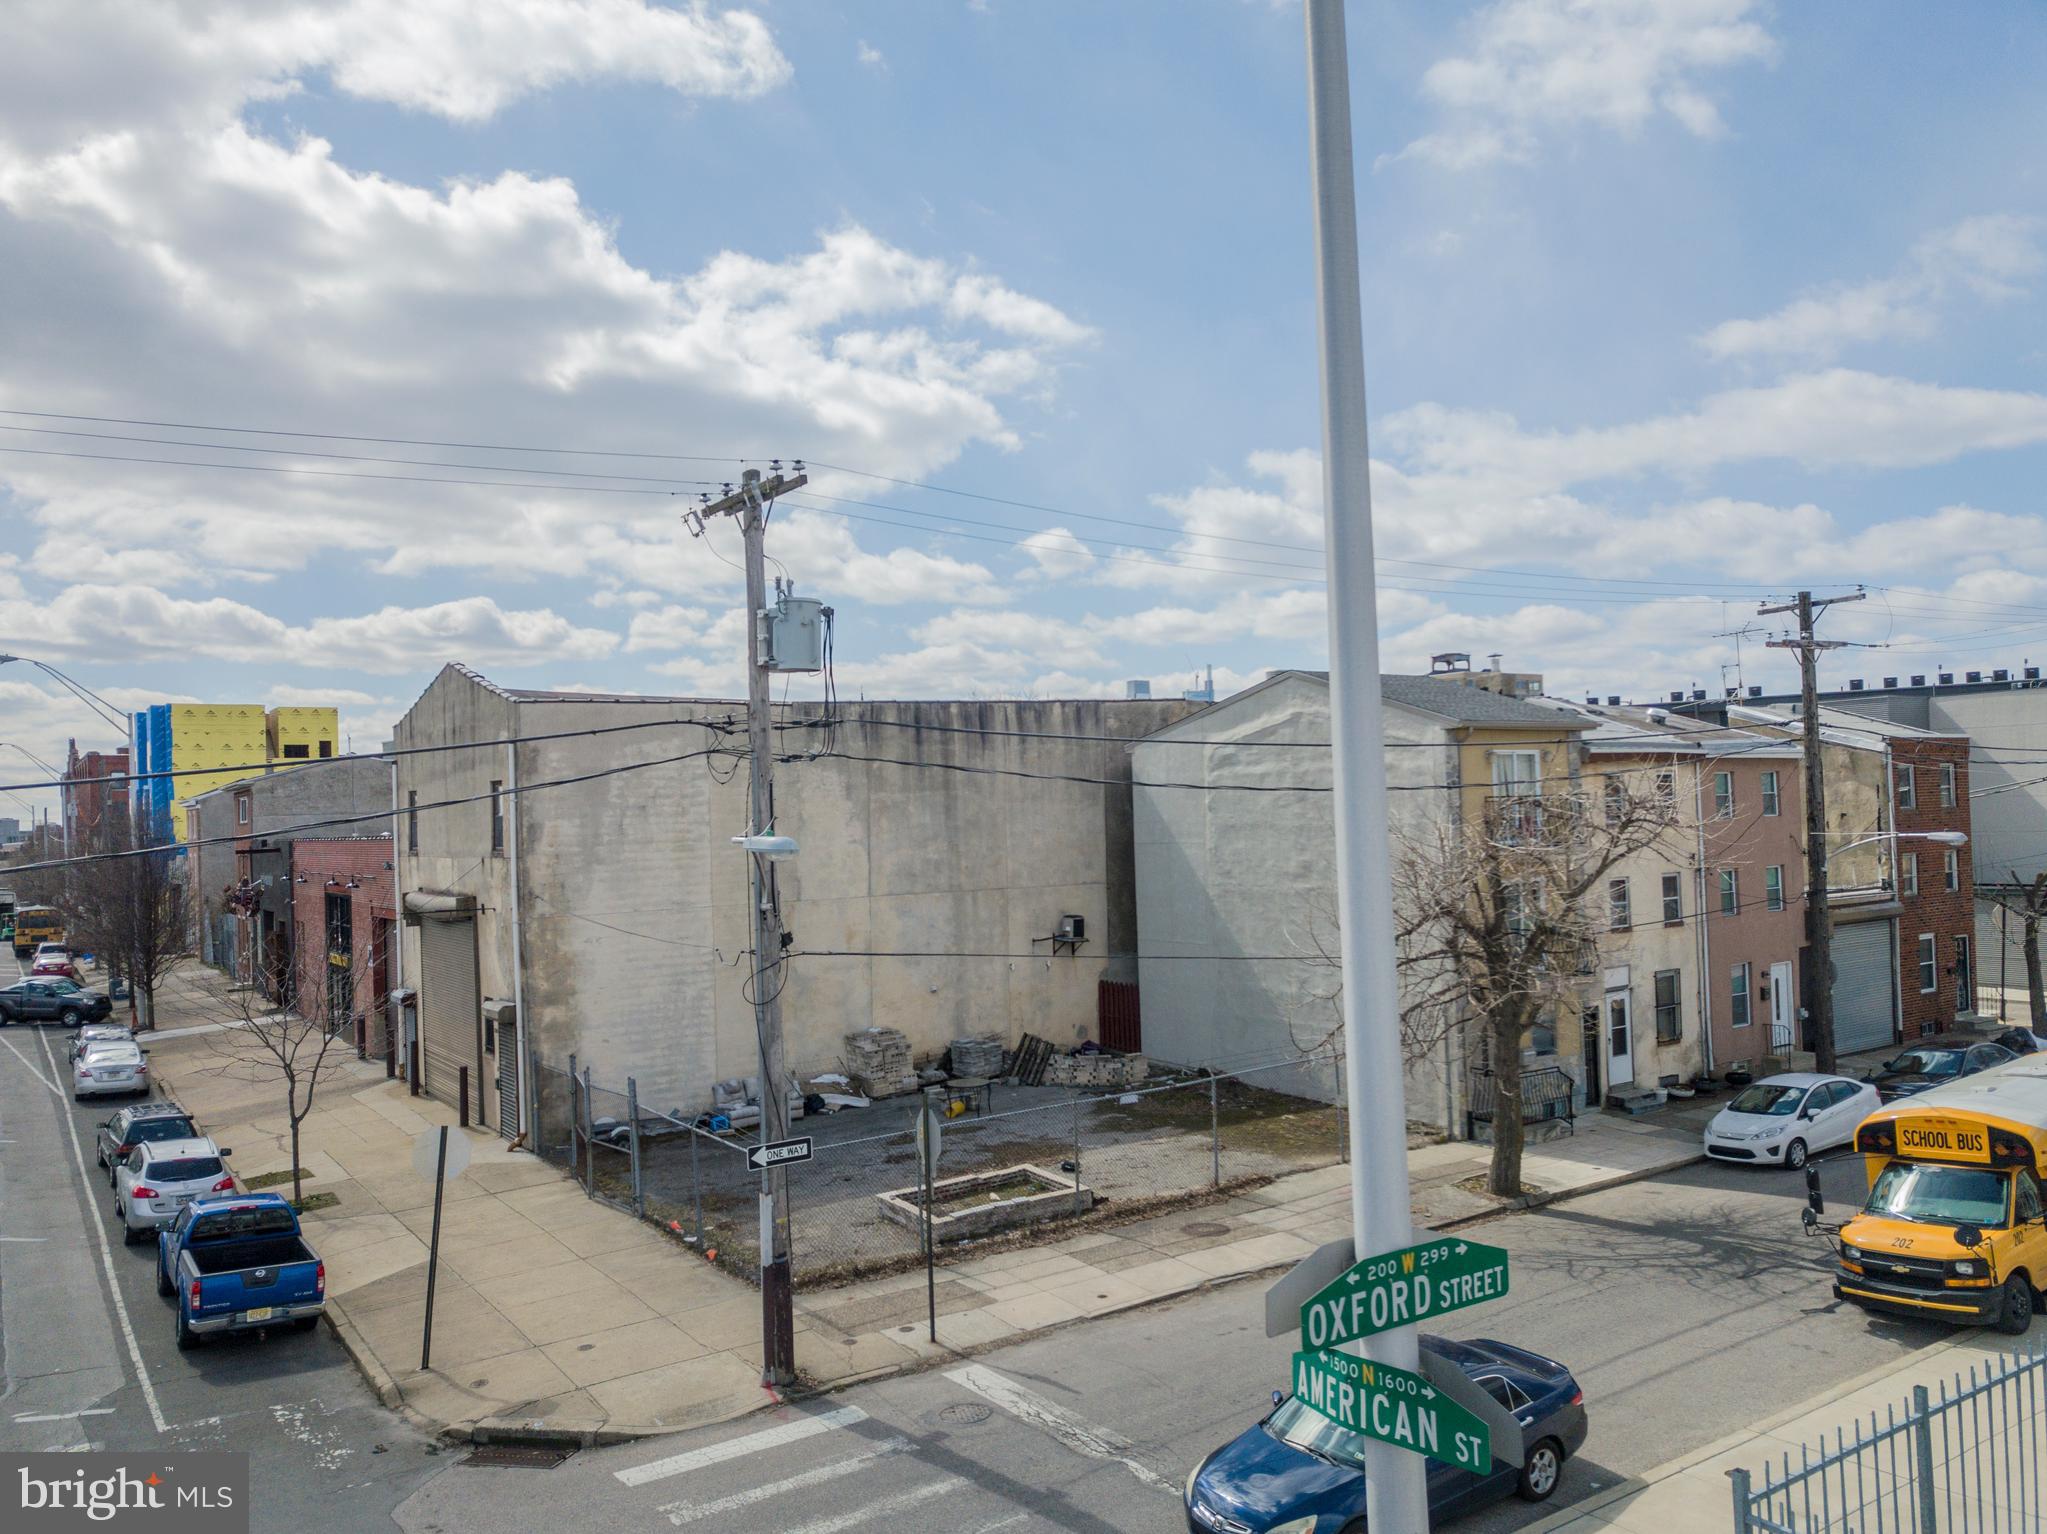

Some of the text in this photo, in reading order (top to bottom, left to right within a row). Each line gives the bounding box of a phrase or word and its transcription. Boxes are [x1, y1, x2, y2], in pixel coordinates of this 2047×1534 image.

[767, 1145, 805, 1160] ONE WAY
[1903, 1129, 1983, 1151] SCHOOL BUS
[1891, 1237, 1914, 1249] 202
[1368, 1246, 1449, 1280] 200 W 299
[1308, 1266, 1503, 1346] OXFORD STREET
[1329, 1359, 1417, 1396] 1500 N 1600
[1297, 1360, 1481, 1466] AMERICAN ST
